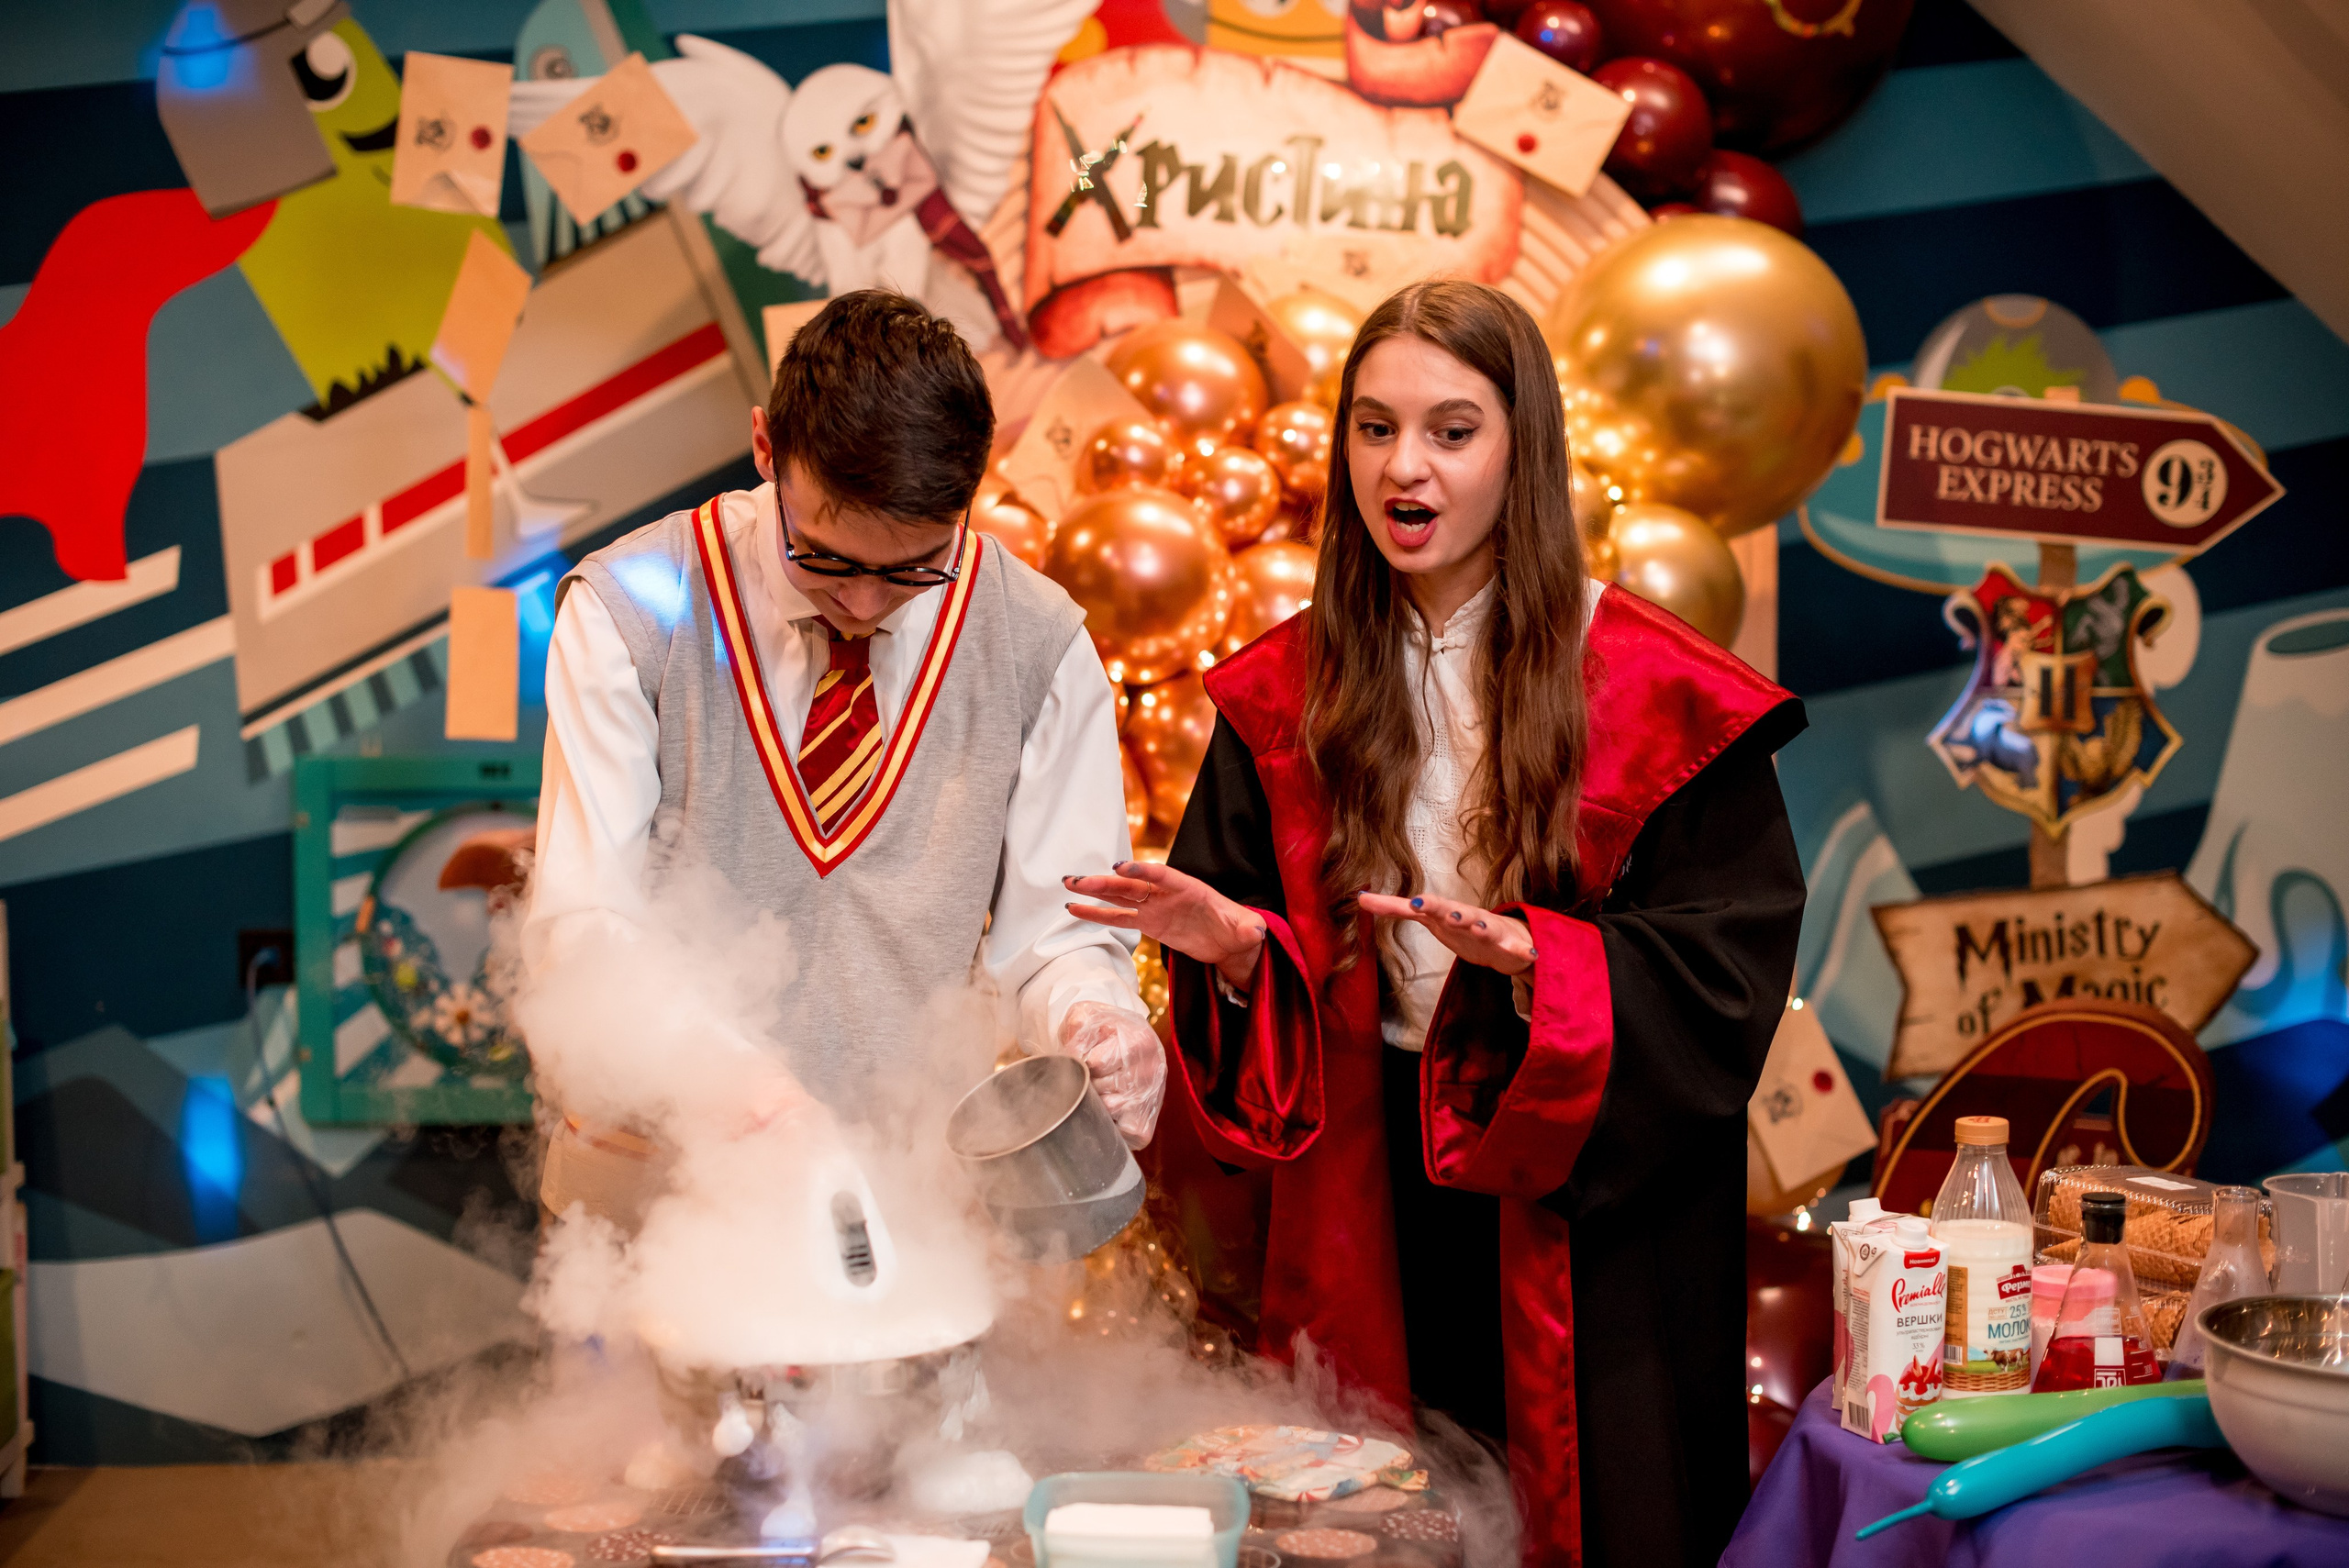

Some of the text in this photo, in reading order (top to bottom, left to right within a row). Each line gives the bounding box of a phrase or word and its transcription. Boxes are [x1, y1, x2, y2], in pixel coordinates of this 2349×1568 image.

[1909, 424, 2140, 479] HOGWARTS
[1937, 464, 2104, 513] EXPRESS
[1954, 907, 2161, 991] Ministry
[1957, 987, 2002, 1038] of
[1897, 1313, 1943, 1328] ВЕРШКИ
